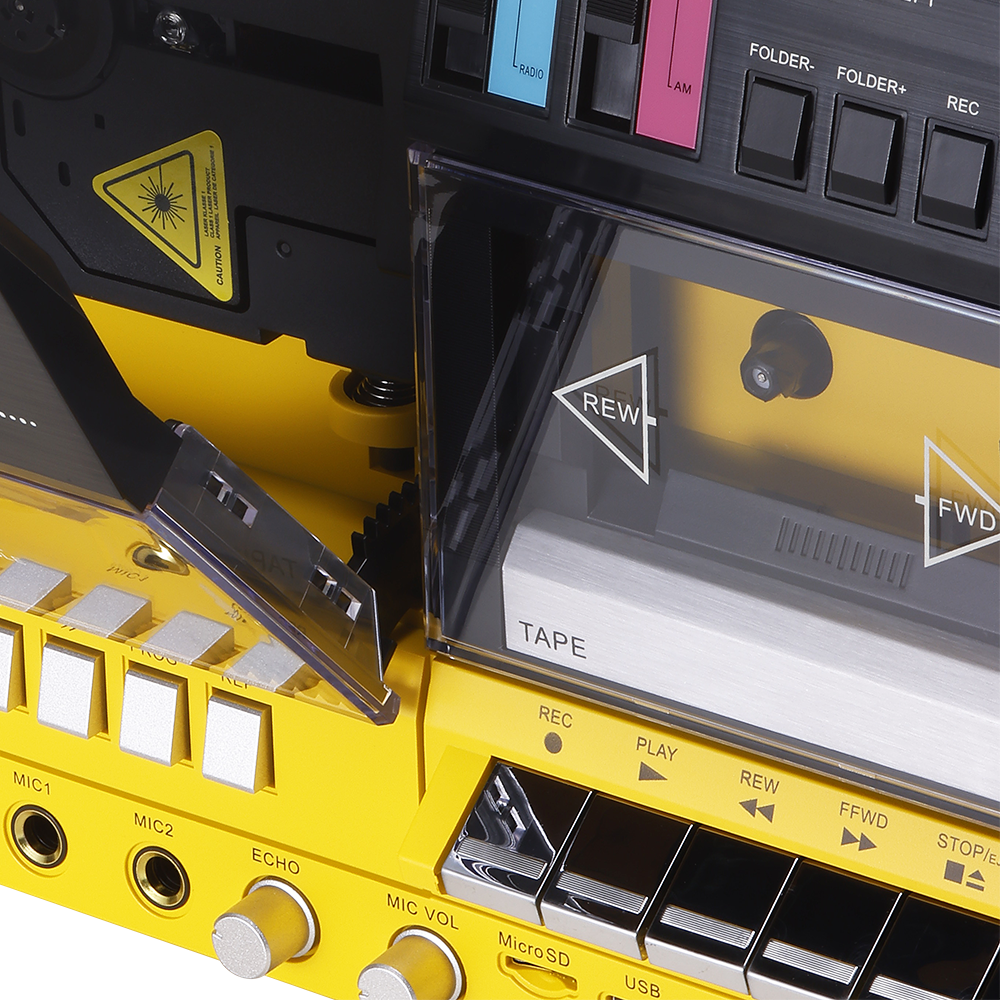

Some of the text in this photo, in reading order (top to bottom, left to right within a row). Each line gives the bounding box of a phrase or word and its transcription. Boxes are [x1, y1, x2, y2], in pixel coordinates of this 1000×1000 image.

[749, 42, 815, 72] FOLDER-
[519, 63, 544, 80] RADIO
[836, 66, 907, 95] FOLDER+
[673, 81, 692, 95] AM
[946, 95, 980, 116] REC
[215, 245, 224, 286] CAUTION
[583, 391, 640, 426] REW
[939, 497, 997, 532] FWD
[519, 620, 587, 659] TAPE
[538, 704, 573, 729] REC
[635, 736, 678, 762] PLAY
[13, 771, 51, 795] MIC1
[740, 769, 780, 795] REW
[134, 812, 174, 838] MIC2
[839, 801, 889, 830] FFWD
[252, 847, 301, 875] ECHO
[386, 893, 459, 930] MIC VOL
[498, 931, 571, 968] MicroSD
[624, 975, 661, 998] USB
